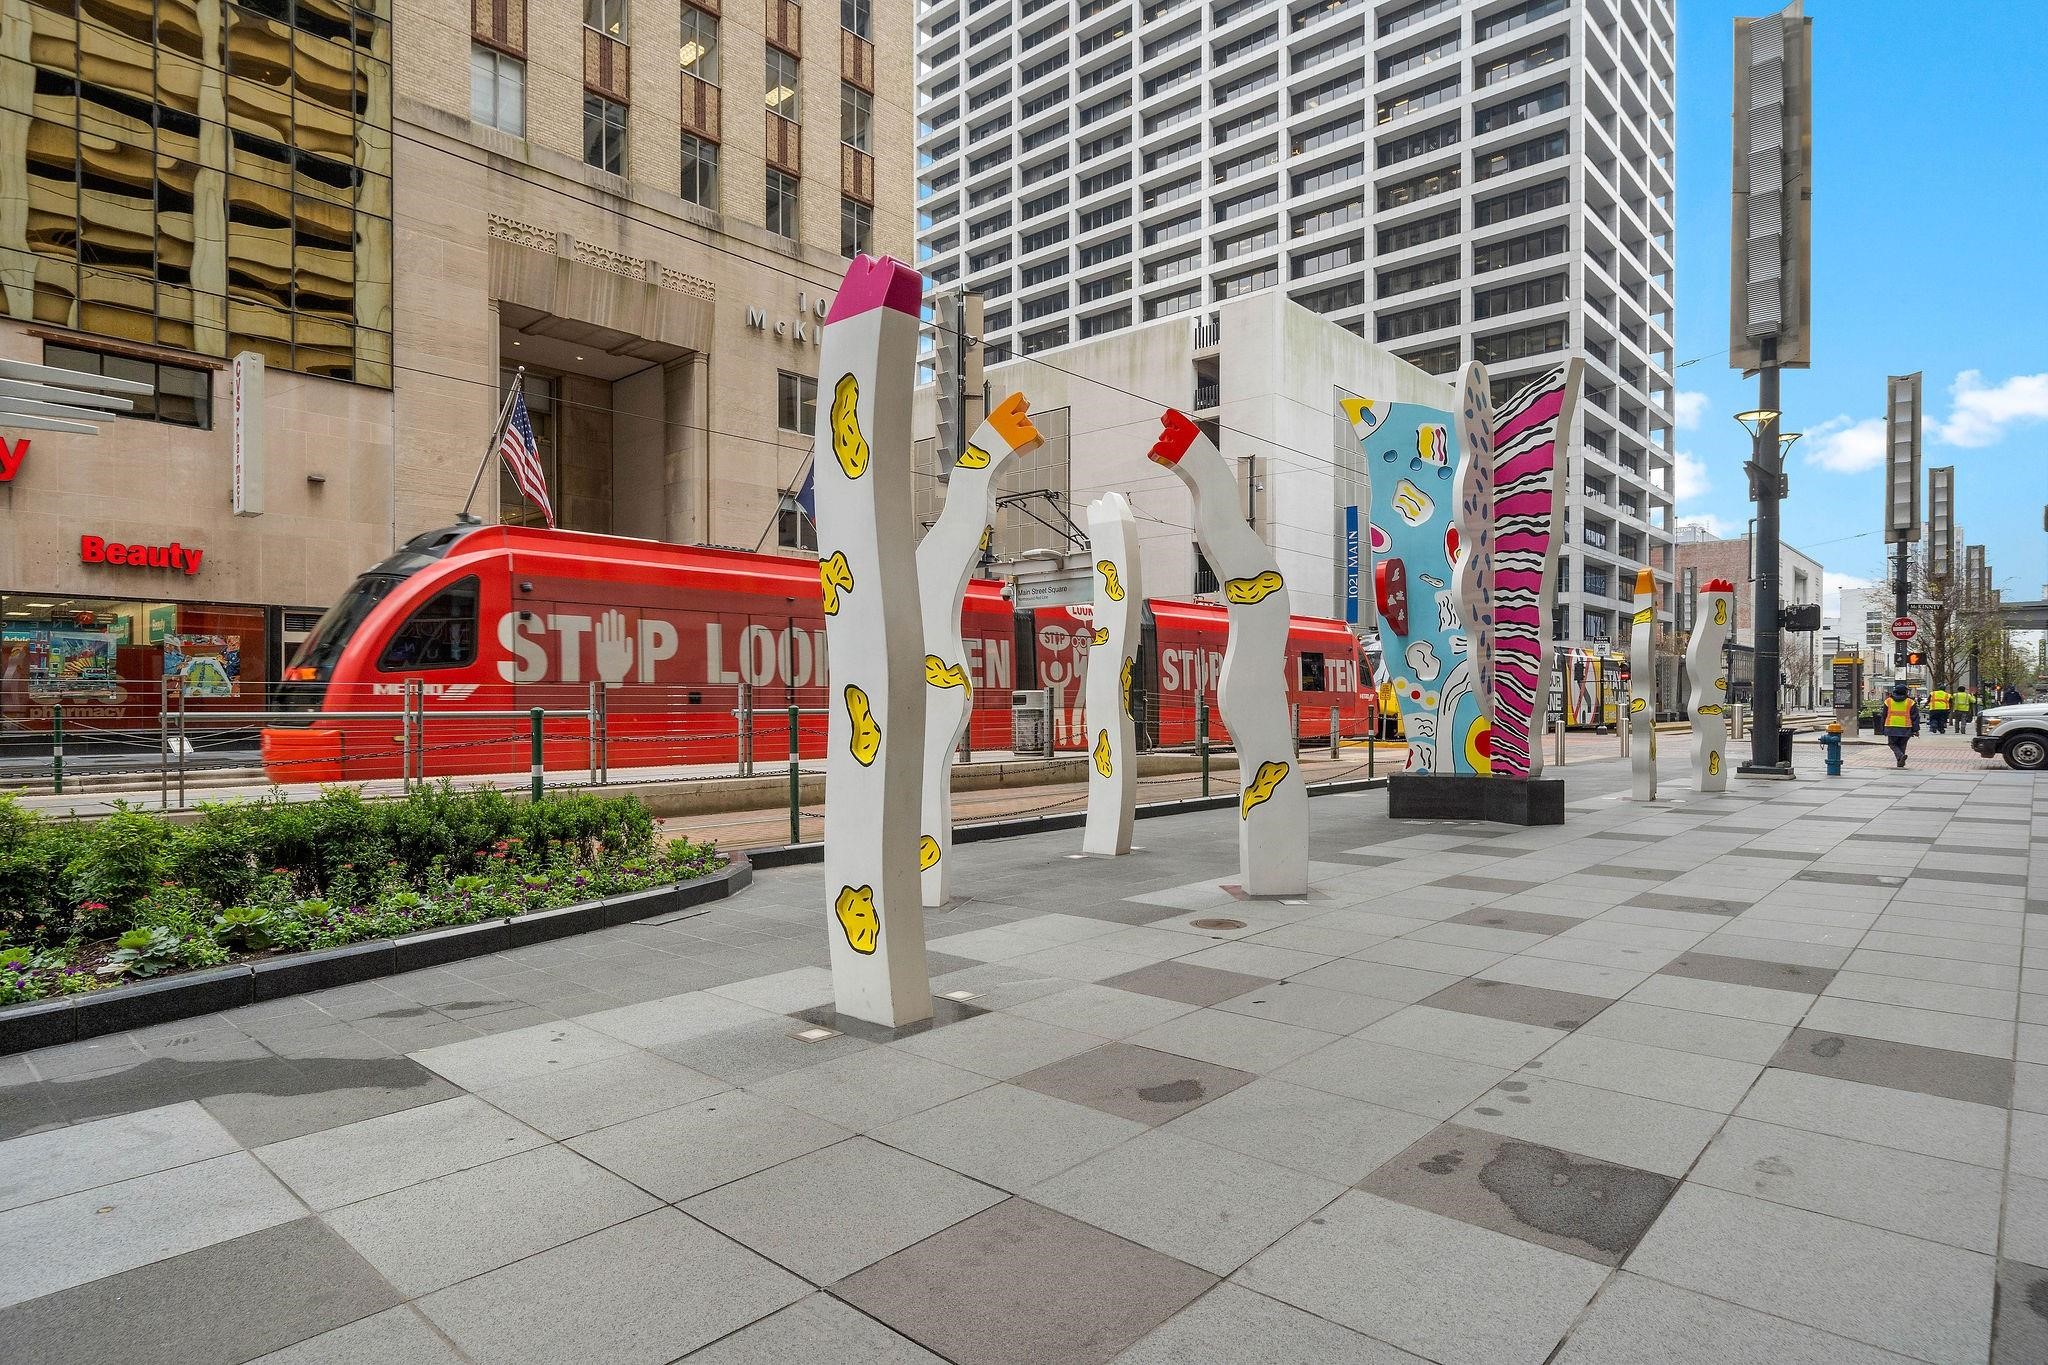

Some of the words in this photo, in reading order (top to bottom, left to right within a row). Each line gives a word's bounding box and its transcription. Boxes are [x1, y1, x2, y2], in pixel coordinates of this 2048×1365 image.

[81, 534, 203, 576] Beauty
[1348, 530, 1358, 568] MAIN
[1018, 587, 1031, 596] Main
[1031, 586, 1047, 595] Street
[1048, 585, 1068, 595] Square
[1348, 574, 1358, 598] 1021
[30, 704, 126, 718] phrmacy
